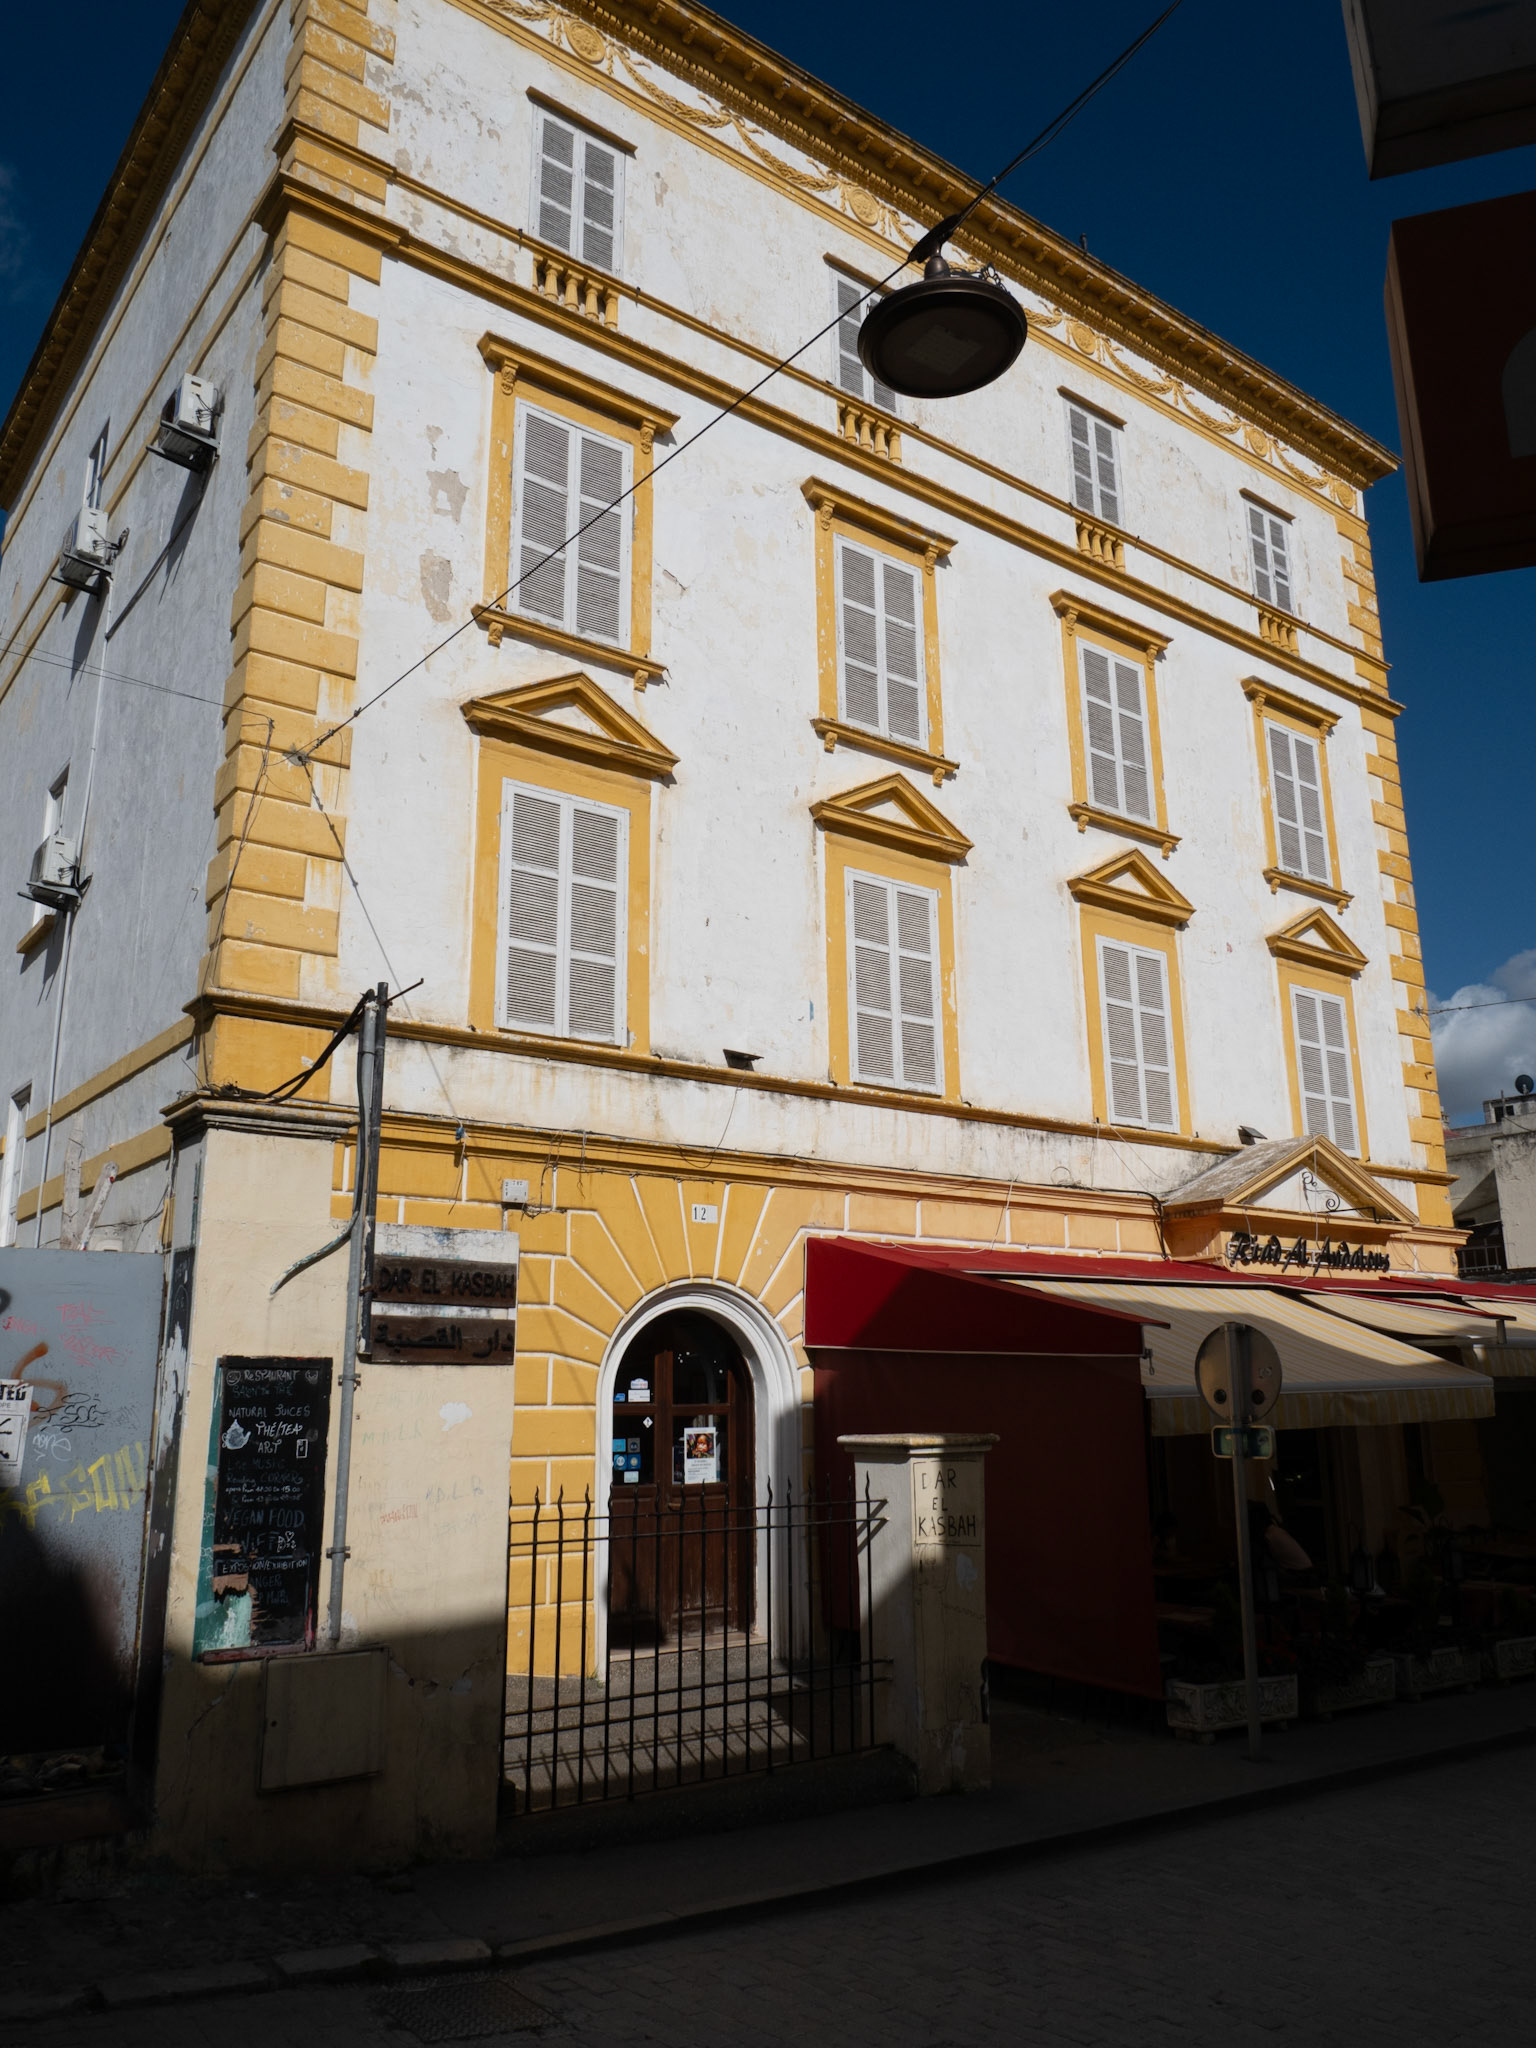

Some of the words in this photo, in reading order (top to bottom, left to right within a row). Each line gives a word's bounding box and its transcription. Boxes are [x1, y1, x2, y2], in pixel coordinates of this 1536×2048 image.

[694, 1206, 707, 1221] 12
[379, 1266, 412, 1294] DAR
[421, 1268, 441, 1294] EL
[451, 1270, 516, 1298] KASBAH
[472, 1326, 514, 1358] دار
[257, 1438, 282, 1454] ART
[932, 1497, 948, 1511] EL
[918, 1515, 977, 1537] KASBAH
